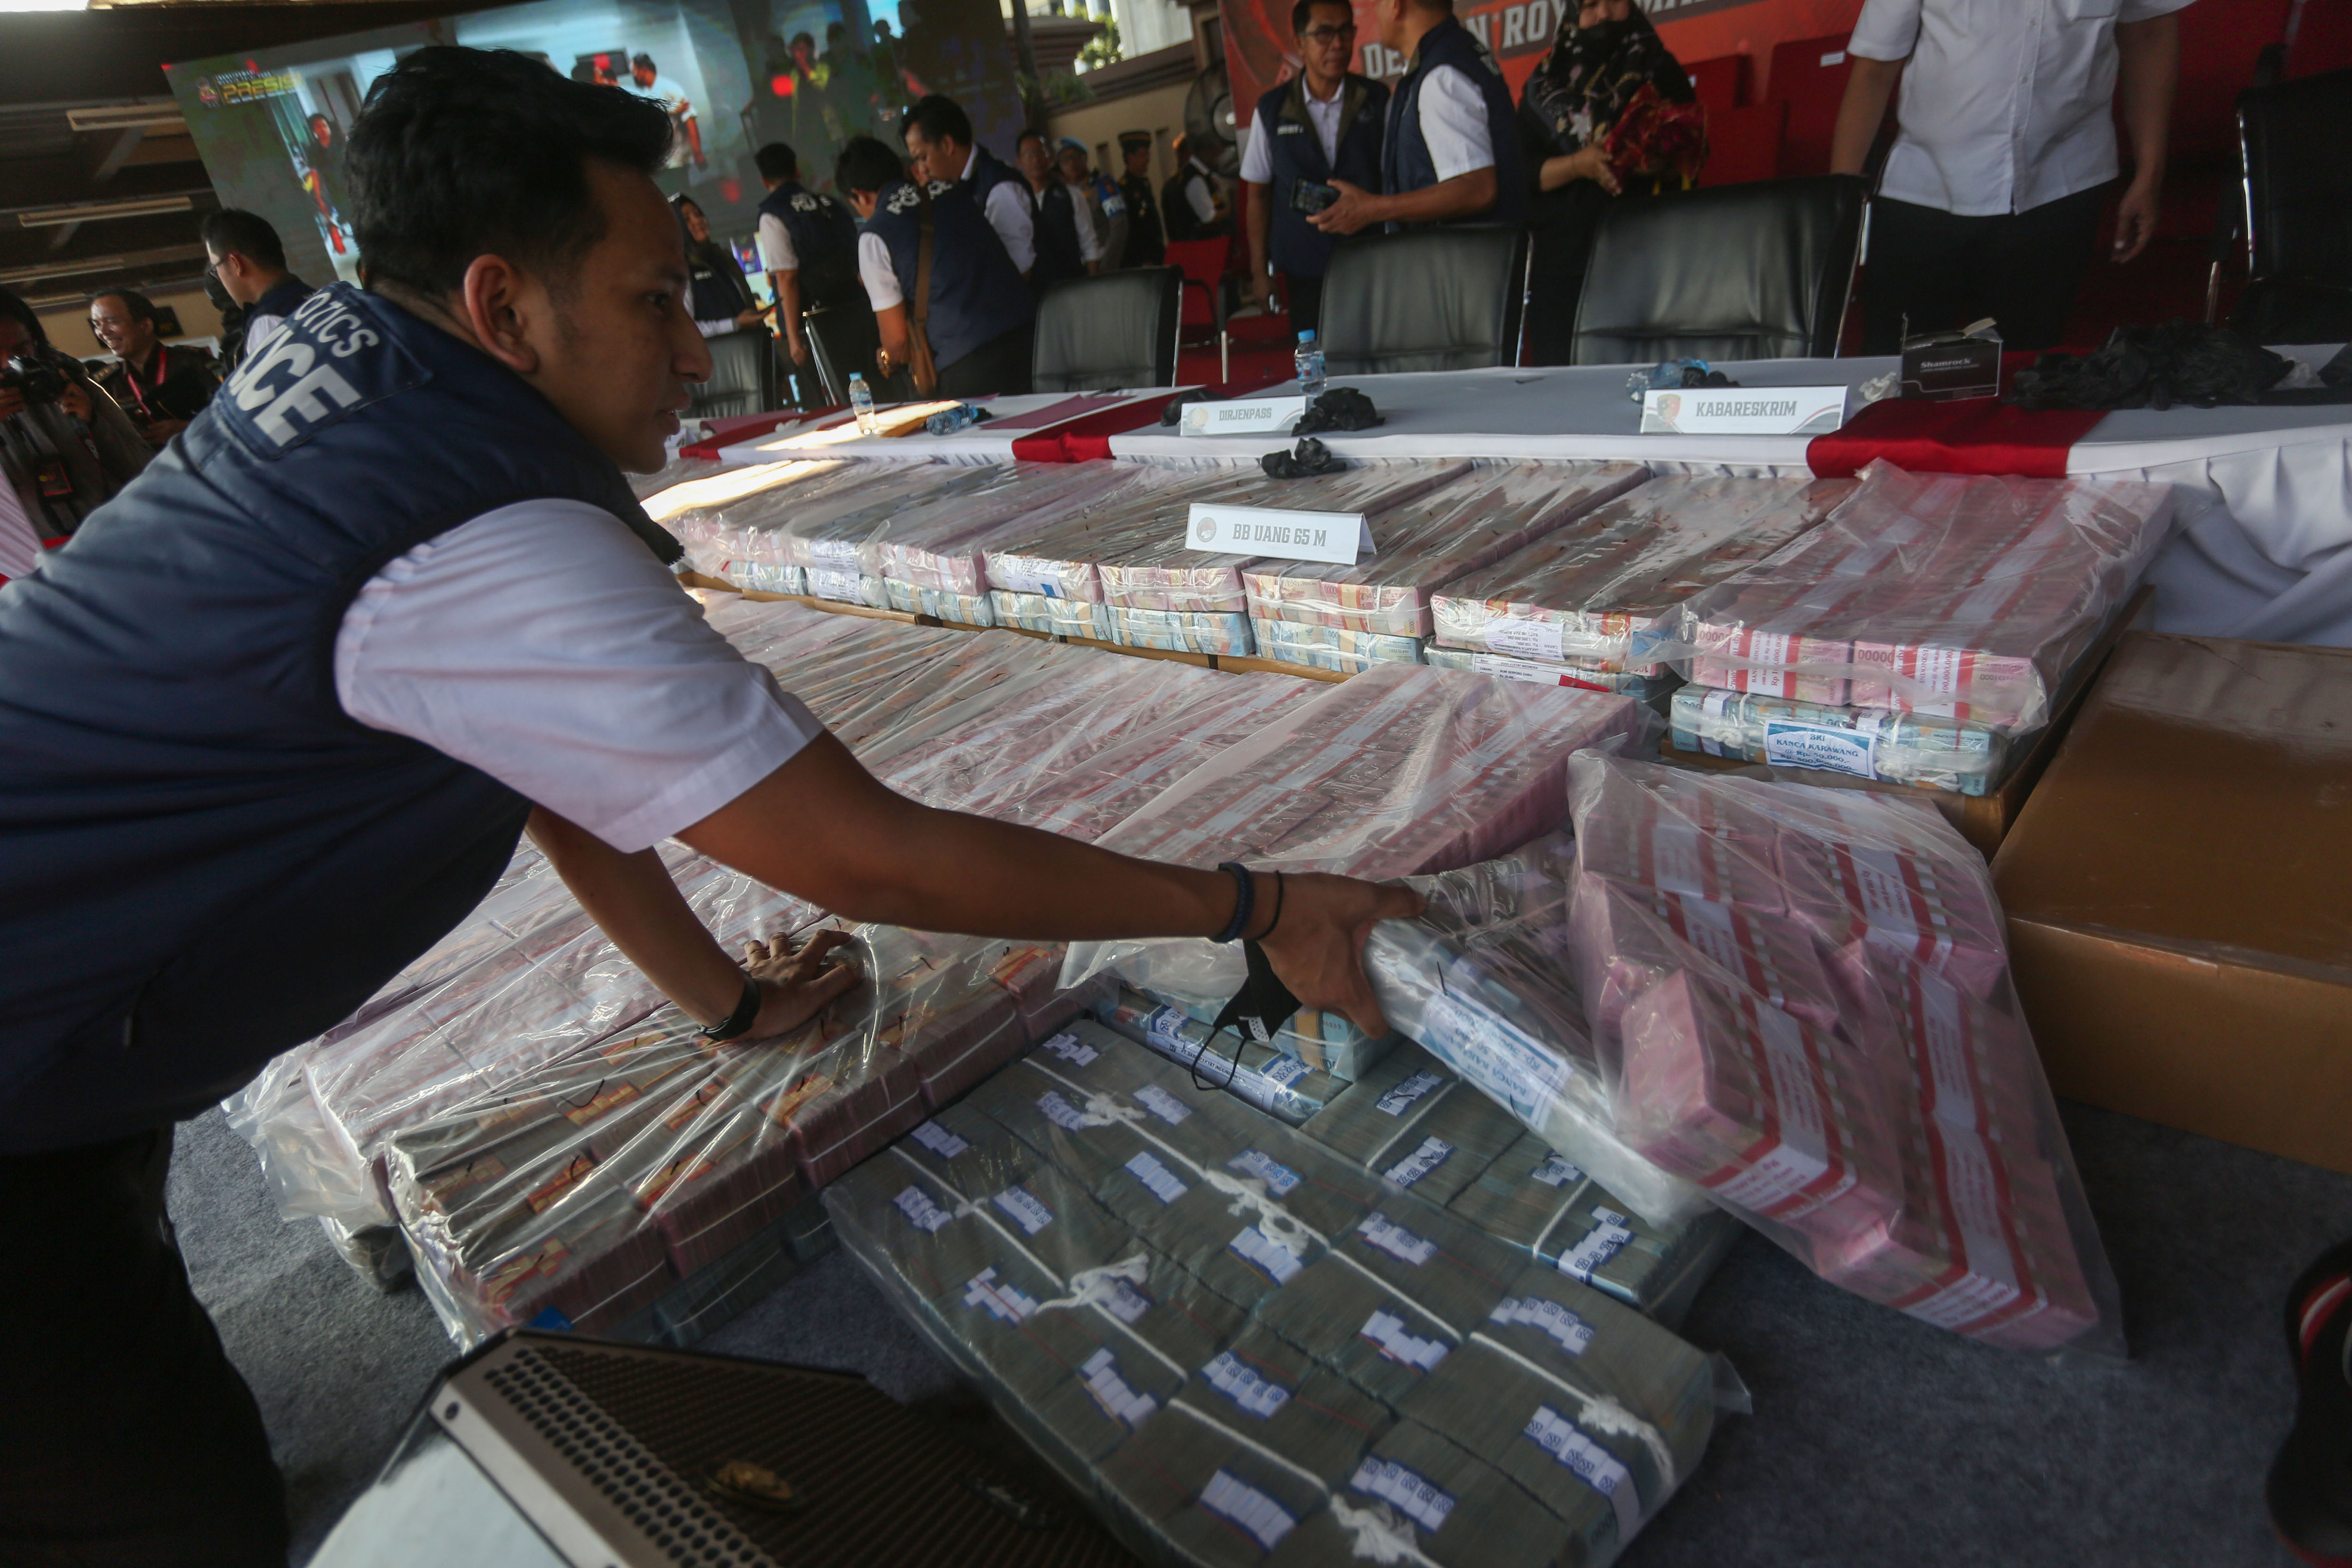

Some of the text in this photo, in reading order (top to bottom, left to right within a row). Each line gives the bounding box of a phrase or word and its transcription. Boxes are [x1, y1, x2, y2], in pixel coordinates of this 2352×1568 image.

[1502, 0, 1566, 49] ROY
[294, 292, 379, 358] OTICS
[1920, 358, 1971, 368] Shamrock
[228, 325, 362, 447] LICE
[1219, 407, 1271, 421] DIRJENPASS
[1696, 401, 1797, 416] KABARESKRIM
[1232, 523, 1327, 547] BB UANG 65 M
[1920, 649, 1928, 683] INDONESI
[1771, 675, 1780, 687] Rp
[1776, 739, 1858, 757] KANCA KARAWANG
